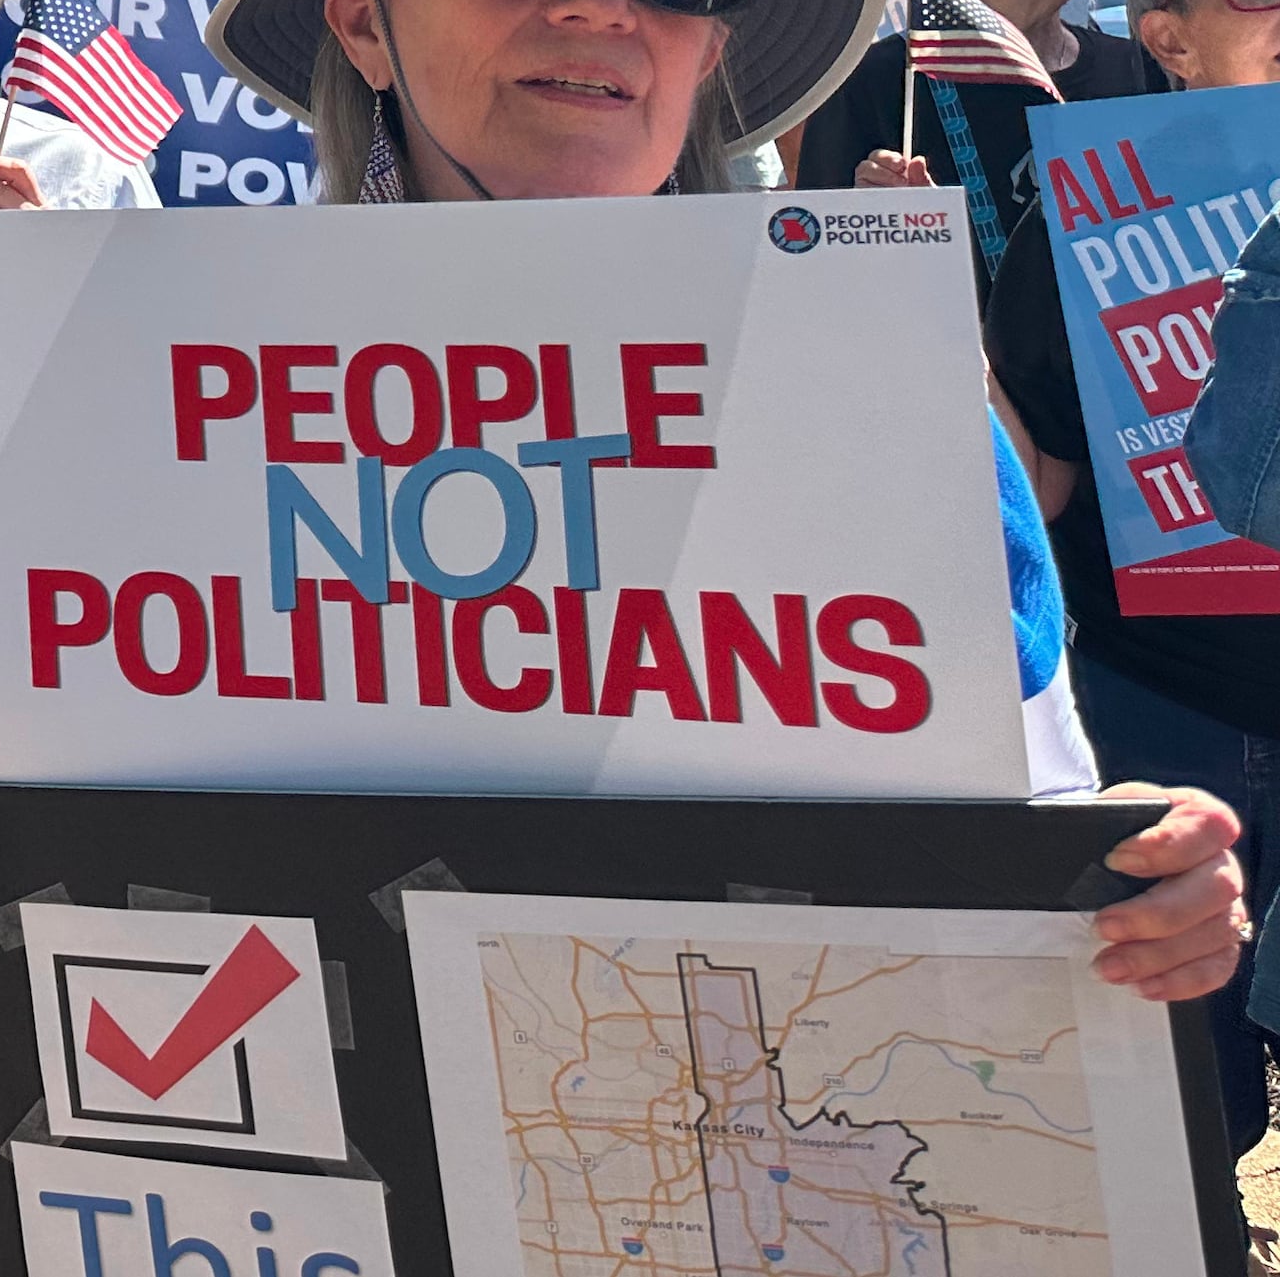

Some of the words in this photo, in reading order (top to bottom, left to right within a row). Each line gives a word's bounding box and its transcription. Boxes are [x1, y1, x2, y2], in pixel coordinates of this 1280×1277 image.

[1047, 138, 1175, 232] ALL
[825, 214, 899, 229] PEOPLE
[904, 212, 948, 227] NOT
[826, 229, 951, 245] POLITICIANS
[170, 342, 717, 470] PEOPLE
[1116, 425, 1143, 454] IS
[265, 433, 632, 612] NOT
[27, 568, 934, 734] POLITICIANS
[794, 1018, 829, 1028] Liberty
[672, 1120, 728, 1134] Kansas
[733, 1124, 764, 1138] City
[790, 1138, 875, 1150] Independence
[620, 1217, 673, 1230] Overland
[677, 1222, 704, 1232] Park
